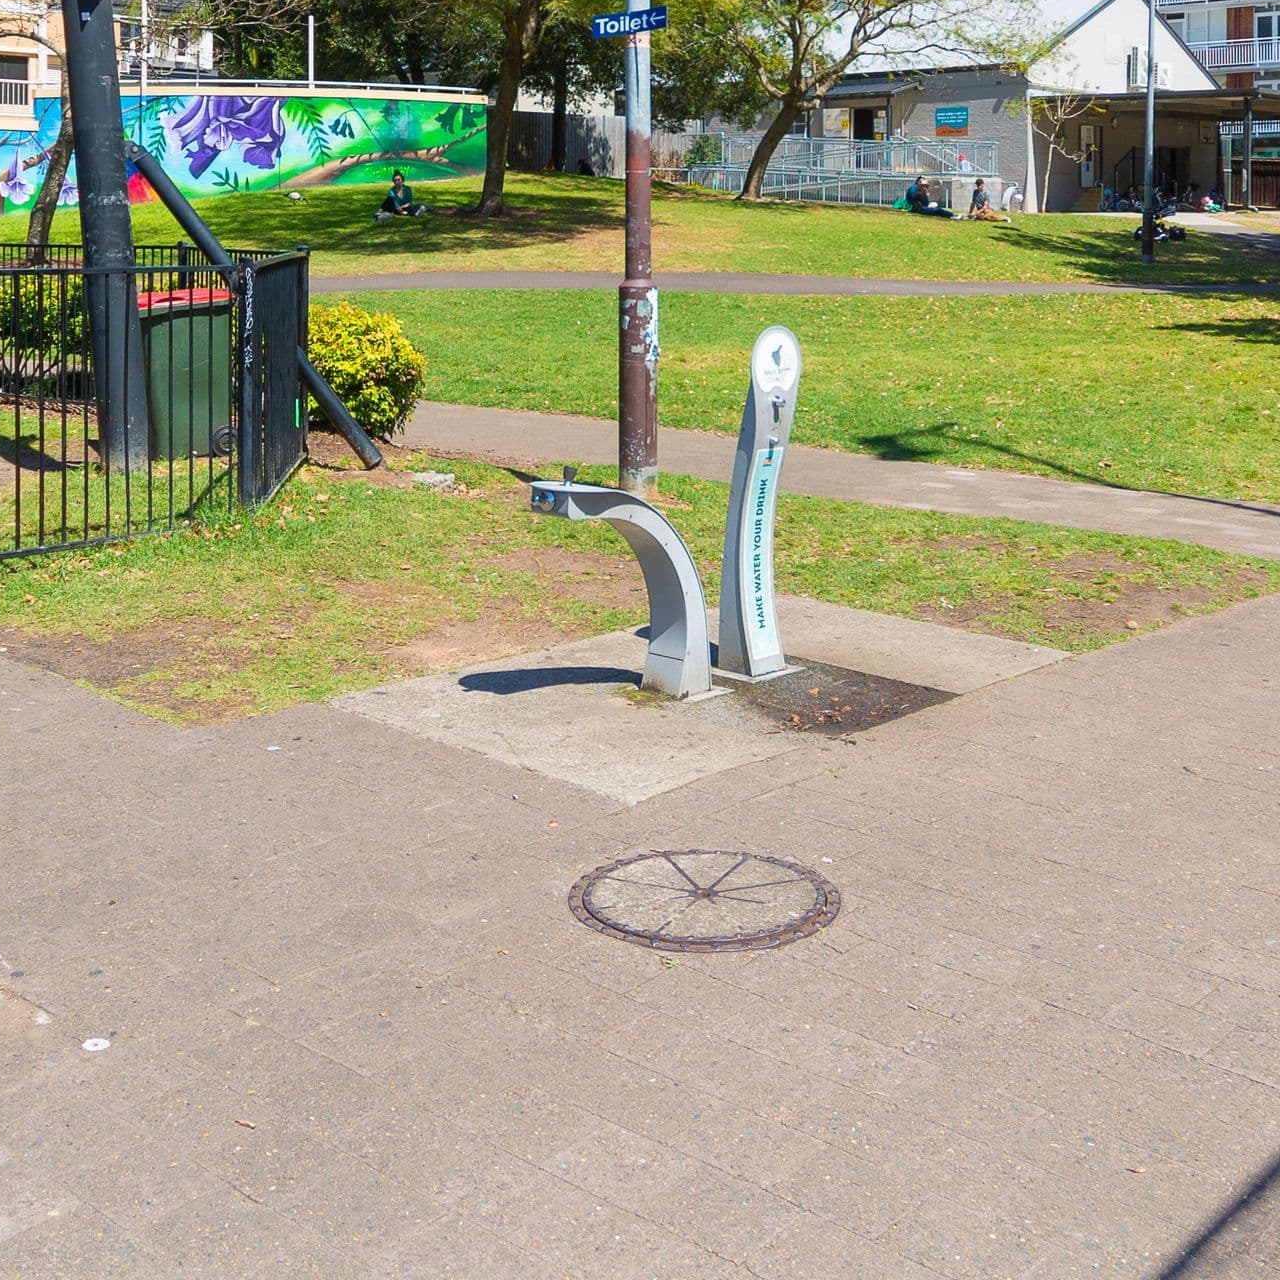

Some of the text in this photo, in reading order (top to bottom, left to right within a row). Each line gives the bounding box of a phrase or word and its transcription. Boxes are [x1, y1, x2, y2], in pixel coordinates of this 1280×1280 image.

[595, 13, 648, 34] Toilet
[753, 478, 769, 629] MAKE WATER YOUR DRINK
